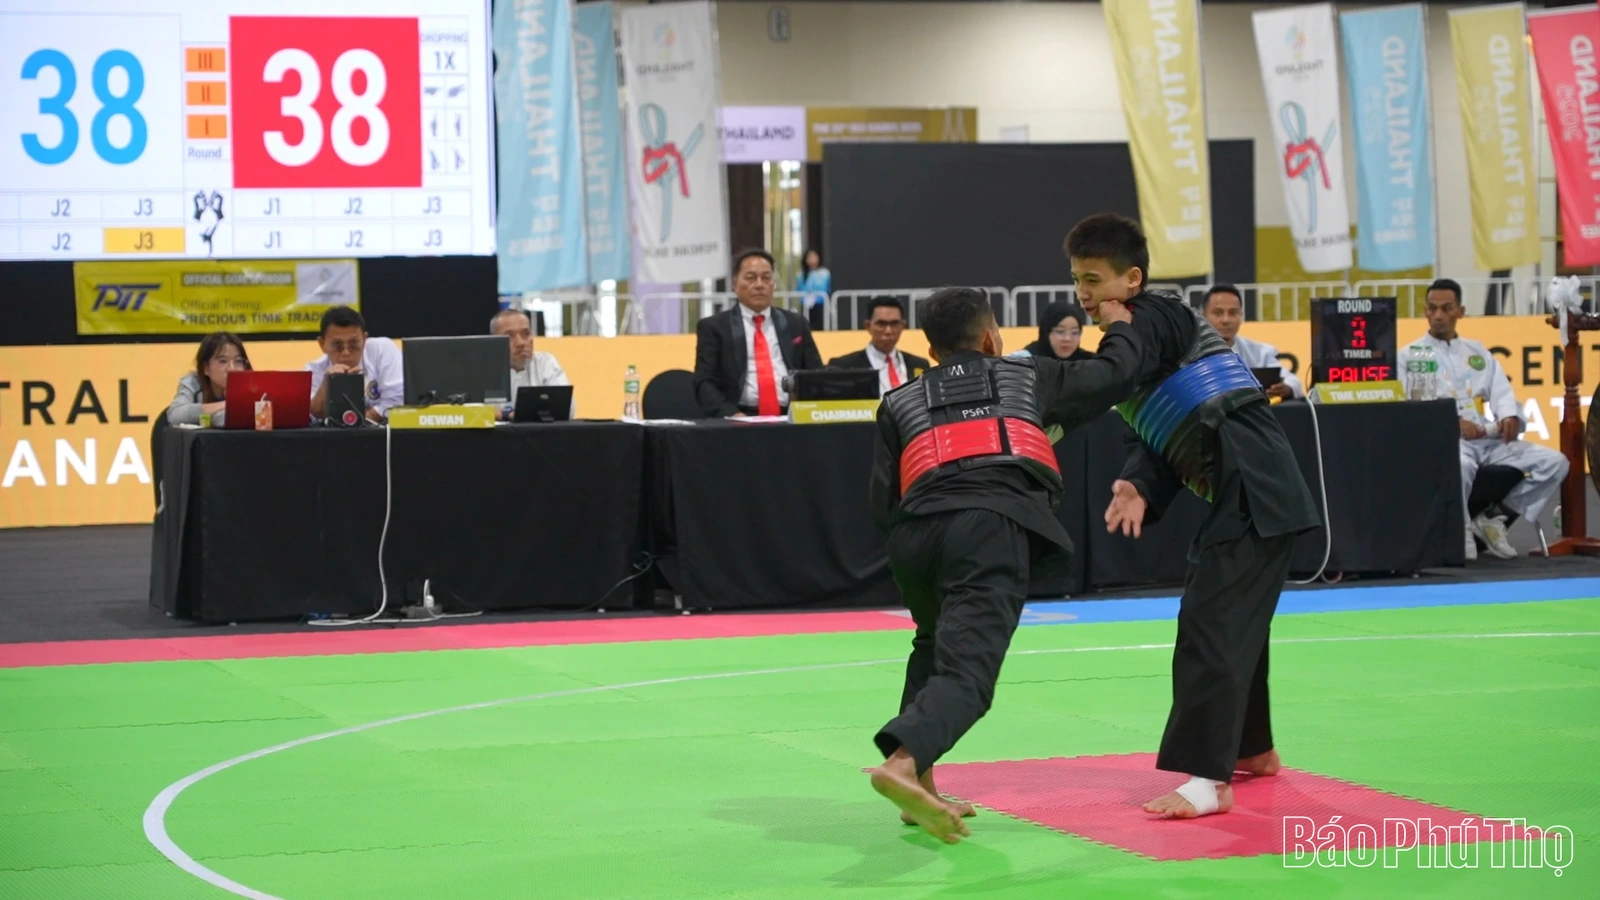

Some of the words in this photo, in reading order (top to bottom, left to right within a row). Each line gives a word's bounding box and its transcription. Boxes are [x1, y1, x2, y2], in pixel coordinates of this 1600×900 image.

[433, 50, 457, 70] 1X
[20, 48, 148, 165] 38
[262, 48, 390, 167] 38
[188, 146, 222, 158] Round
[51, 199, 71, 216] J2
[133, 198, 153, 216] J3
[263, 197, 281, 215] J1
[344, 197, 363, 214] J2
[423, 196, 442, 214] J3
[52, 232, 72, 250] J2
[134, 232, 154, 250] J3
[264, 231, 281, 248] J1
[345, 230, 364, 248] J2
[423, 229, 442, 247] J3
[183, 273, 222, 285] OFFICIAL
[181, 298, 219, 310] Official
[224, 298, 260, 312] Timing
[1337, 299, 1372, 313] ROUND
[181, 313, 247, 326] PRECIOUS
[251, 313, 283, 324] TIME
[1343, 349, 1372, 359] TIMER
[1328, 365, 1391, 383] PAUSE
[1330, 391, 1356, 401] TIME
[1356, 389, 1394, 400] KEEPER
[419, 414, 464, 426] DEWAN
[811, 409, 873, 421] CHAIRMAN
[961, 406, 991, 418] PSAT
[1, 437, 152, 488] ANA
